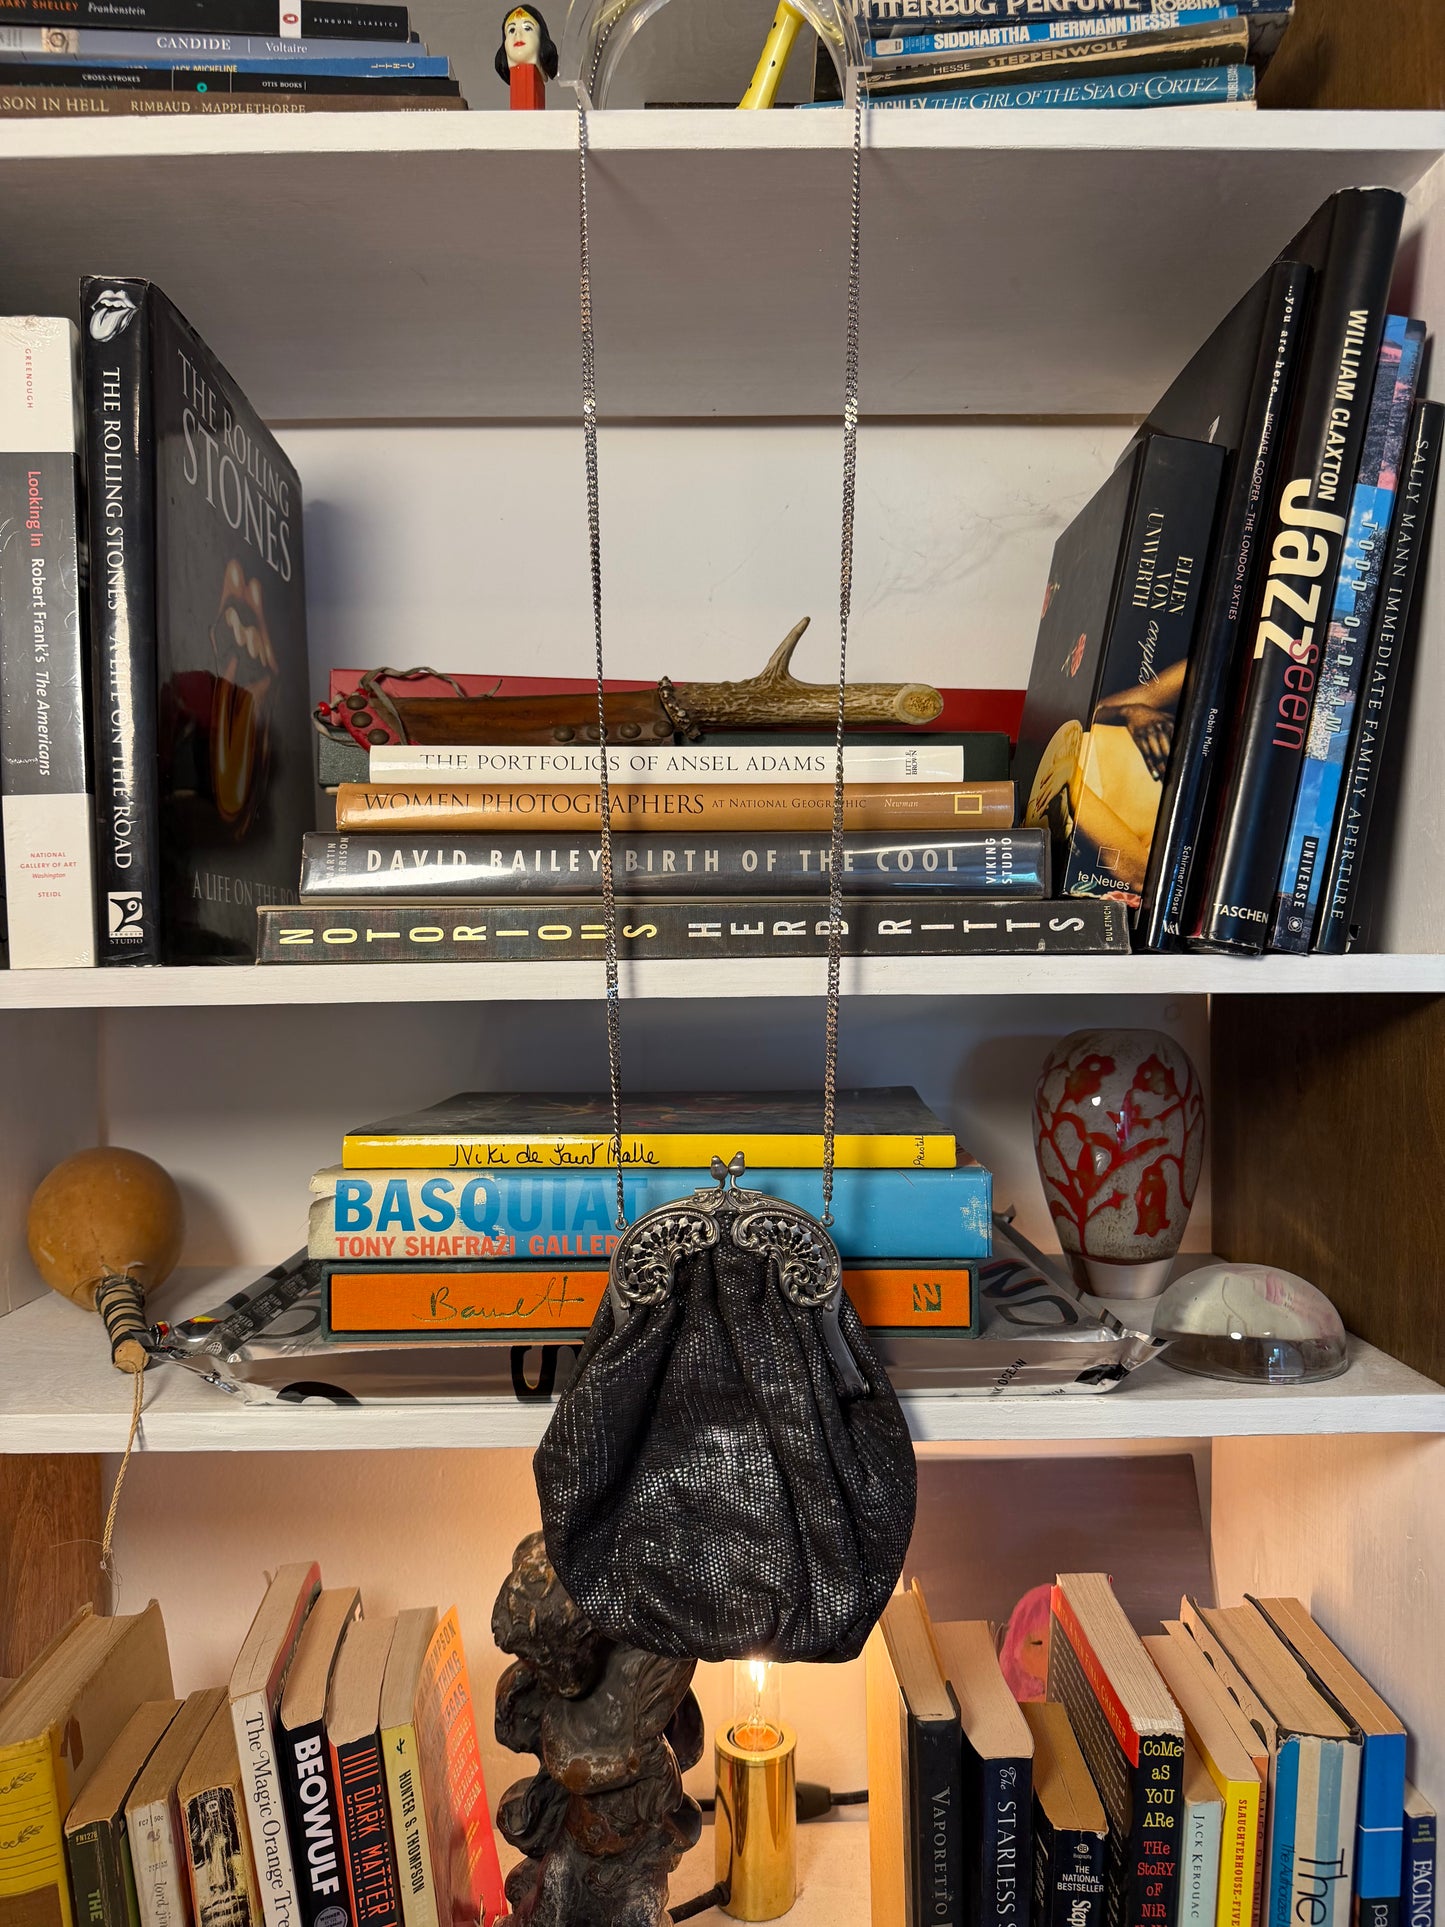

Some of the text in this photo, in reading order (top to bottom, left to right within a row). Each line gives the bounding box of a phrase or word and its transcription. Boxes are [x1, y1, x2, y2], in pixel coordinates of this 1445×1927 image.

[32, 0, 79, 12] SHELLEY
[87, 2, 146, 16] Frankenstein
[313, 17, 398, 28] PENGUIN CLASSICS
[156, 36, 308, 54] CANDIDE Voltaire
[934, 25, 1030, 50] SIDDHARTHA
[1049, 16, 1128, 39] HERMANN
[1130, 11, 1179, 32] HESSE
[933, 39, 1129, 75] HESSE STEPPENWOLF
[82, 74, 141, 83] CROSS-STROKES
[280, 82, 303, 90] BOOKS
[931, 76, 1219, 109] THE GIRL OF THE SEA OF CORTEZ
[42, 99, 306, 114] IN HELL RIMBAUD MAPPLETHORPE
[1278, 330, 1289, 354] are
[25, 348, 33, 409] GREENOUGH
[1316, 310, 1369, 502] WILLIAM CLAXTON
[178, 349, 289, 518] THE ROLLING
[103, 367, 124, 611] THE ROLLING STONES
[183, 408, 291, 582] STONES
[1250, 460, 1266, 501] COOPER
[26, 471, 44, 530] Looking
[31, 533, 42, 547] In
[1244, 513, 1256, 532] THE
[1132, 512, 1165, 608] UNWERTH
[1235, 534, 1252, 581] LONDON
[32, 558, 47, 608] Robert
[1150, 572, 1173, 613] VON
[1168, 556, 1194, 616] ELLEN
[1228, 584, 1242, 620] SIXTIES
[1252, 479, 1346, 750] Jazz seen
[110, 635, 124, 654] A
[1324, 520, 1379, 733] TODD OLDHAM
[1137, 619, 1160, 687] couples
[35, 671, 47, 697] The
[1328, 440, 1430, 920] SALLY MANN IMMEDIATE FAMILY APERTURE
[35, 701, 50, 776] Americans
[111, 708, 131, 743] ON
[113, 751, 132, 797] THE
[420, 754, 468, 770] THE
[630, 755, 658, 771] OF
[667, 755, 738, 771] ANSEL
[746, 755, 826, 771] ADAMS
[364, 793, 919, 814] WOMEN AT NATIONAL Newman
[1171, 708, 1218, 914] Robin Muir Schirmer/Mosel
[114, 804, 132, 869] ROAD
[367, 850, 958, 872] DAVID BAILEY BIRTH OF THE COOL
[985, 837, 997, 884] VIKING
[1001, 837, 1013, 884] STUDIO
[1293, 840, 1316, 908] UNIVERSE
[193, 872, 278, 905] A LIFE ON THE
[279, 917, 1084, 946] NOTORIOUS HERB RITTS
[1103, 905, 1113, 942] BULFINCH
[1213, 903, 1269, 924] TASCHEN
[449, 1137, 604, 1167] Niki de Saint
[912, 1136, 925, 1167] Prestel
[334, 1177, 649, 1240] BASQUIAT
[335, 1236, 516, 1257] TONY SHAFRAZI
[997, 1358, 1028, 1386] OCEAN
[1085, 1653, 1100, 1691] FINAL
[1101, 1684, 1127, 1742] CHAPTER
[1143, 1740, 1183, 1757] CoMe
[1151, 1765, 1171, 1781] aS
[244, 1711, 285, 1889] The Magic Orange
[398, 1769, 415, 1816] HUNTER
[463, 1780, 483, 1817] DREAM
[1146, 1788, 1176, 1804] YoU
[293, 1735, 340, 1896] BEOWULF
[404, 1817, 418, 1832] S.
[1142, 1815, 1175, 1829] ARe
[353, 1785, 393, 1918] DARK MATTER
[931, 1786, 951, 1915] VAPORETTO
[996, 1766, 1017, 1915] The STARLESS
[1143, 1840, 1171, 1855] THe
[406, 1829, 425, 1894] THOMPSON
[1062, 1873, 1100, 1884] NATIONAL
[1074, 1865, 1090, 1874] THE
[1190, 1815, 1205, 1920] JACK KEROUAC
[1231, 1799, 1248, 1927] SLAUGHTERHOUSE-FIVE
[154, 1881, 170, 1907] lord
[1057, 1882, 1105, 1893] BESTSELLER
[1146, 1883, 1163, 1897] oF
[1277, 1843, 1296, 1924] The Authorized
[1295, 1848, 1348, 1926] The
[1410, 1859, 1433, 1927] FACING
[88, 1889, 103, 1922] THE
[1141, 1904, 1167, 1918] NiR
